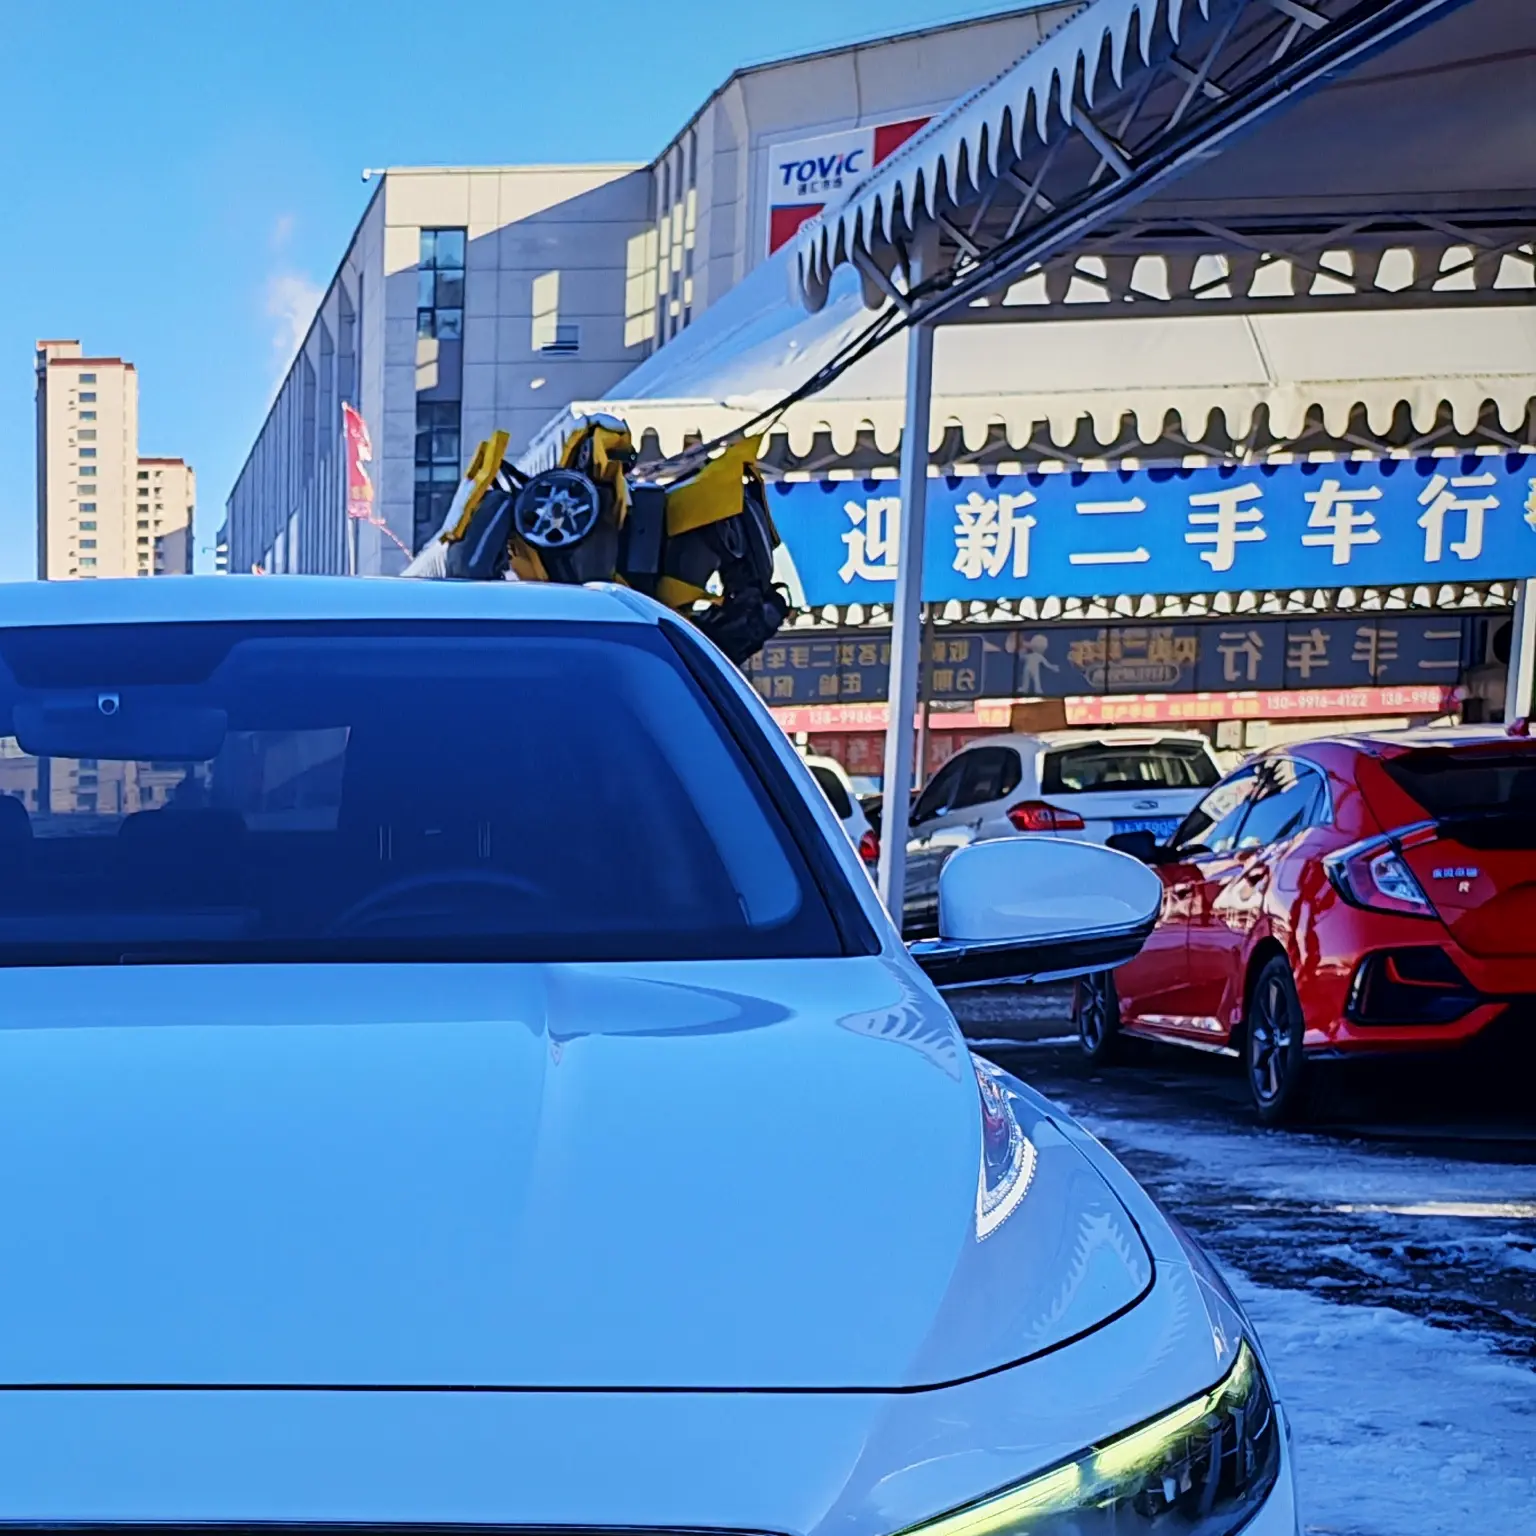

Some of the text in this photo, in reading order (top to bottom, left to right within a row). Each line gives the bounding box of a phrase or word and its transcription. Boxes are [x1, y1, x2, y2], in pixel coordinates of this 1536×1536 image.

[837, 471, 1501, 584] 迎新二手车行
